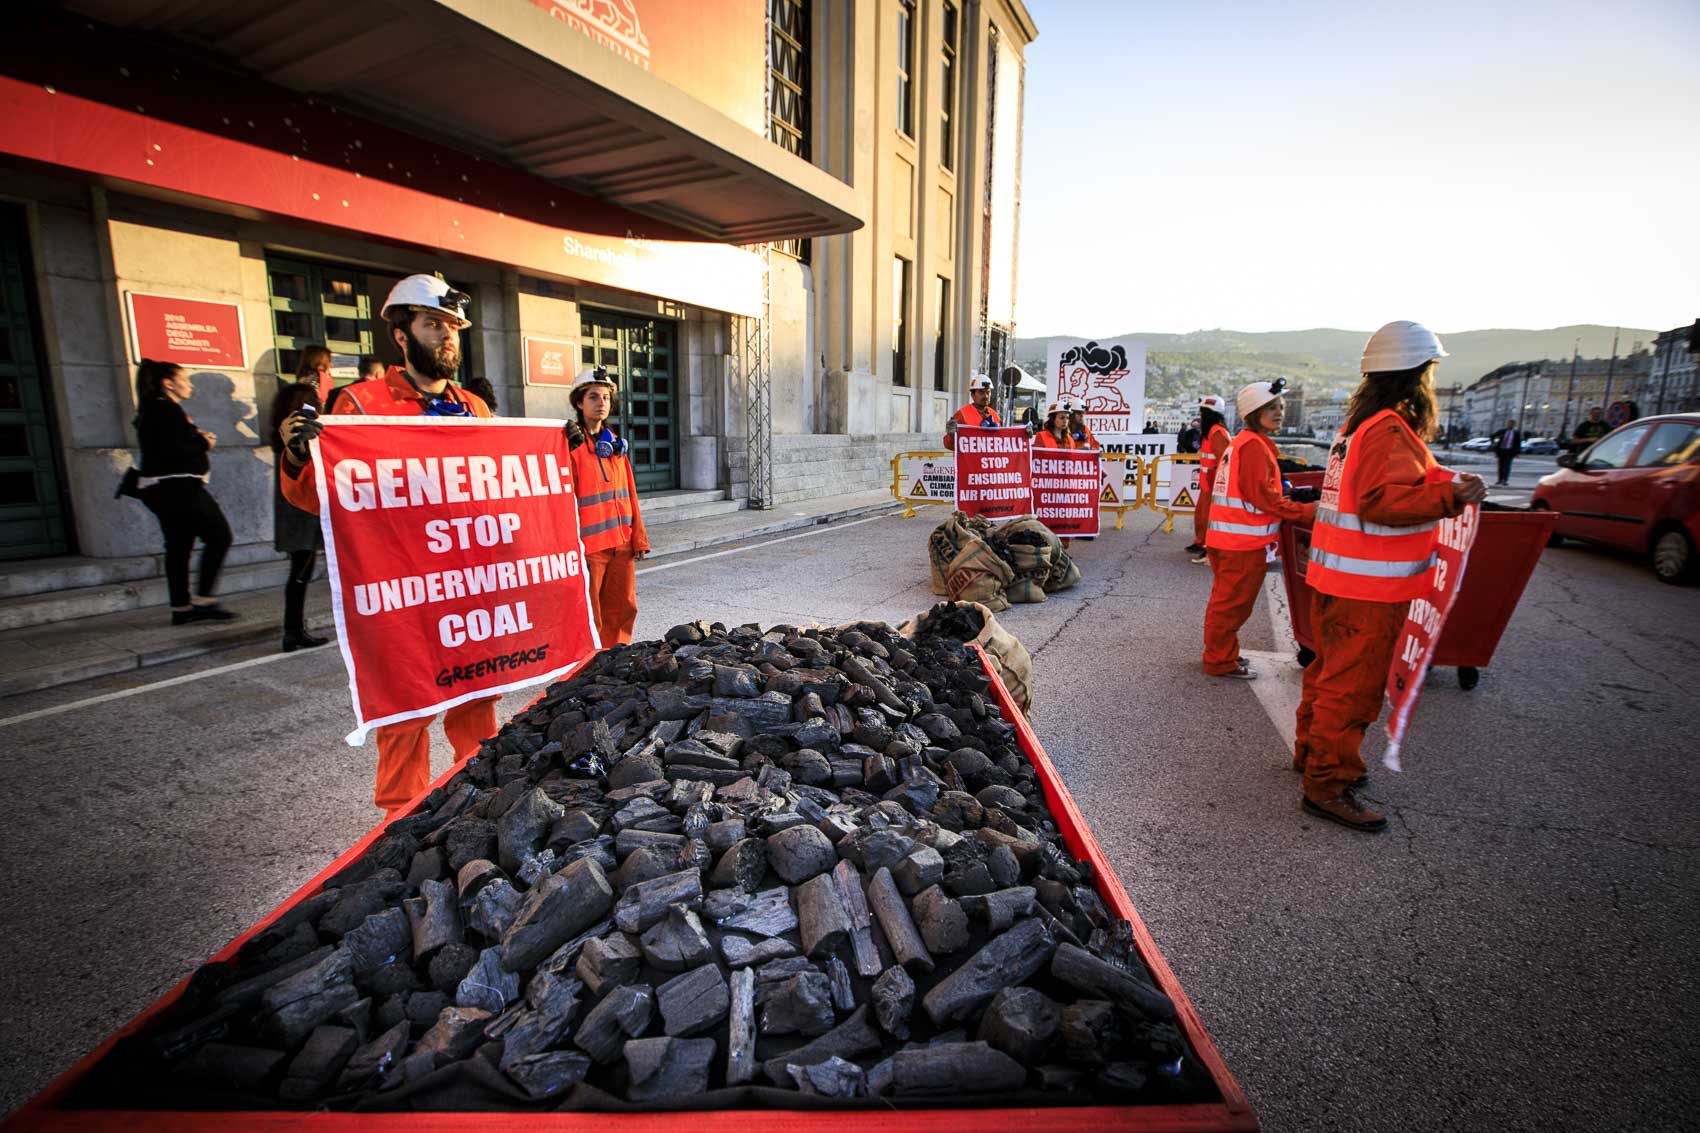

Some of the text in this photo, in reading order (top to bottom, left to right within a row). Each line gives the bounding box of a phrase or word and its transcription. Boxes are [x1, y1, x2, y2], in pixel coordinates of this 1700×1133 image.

[1086, 417, 1130, 432] ERALI
[959, 436, 1028, 453] GENERALI:
[981, 456, 1010, 469] STOP
[1031, 458, 1098, 476] GENERALI:
[333, 453, 572, 513] GENERALI:
[967, 471, 1023, 486] ENSURING
[1031, 477, 1098, 490] CAMBIAMENTI
[959, 486, 1030, 502] AIR POLLUTION
[1040, 492, 1089, 504] CLIMATICI
[1036, 507, 1094, 519] ASSICURATI
[425, 513, 521, 553] STOP
[353, 549, 581, 616] UNDERWRITING
[438, 601, 533, 648] COAL
[435, 643, 549, 688] GREENPEACE
